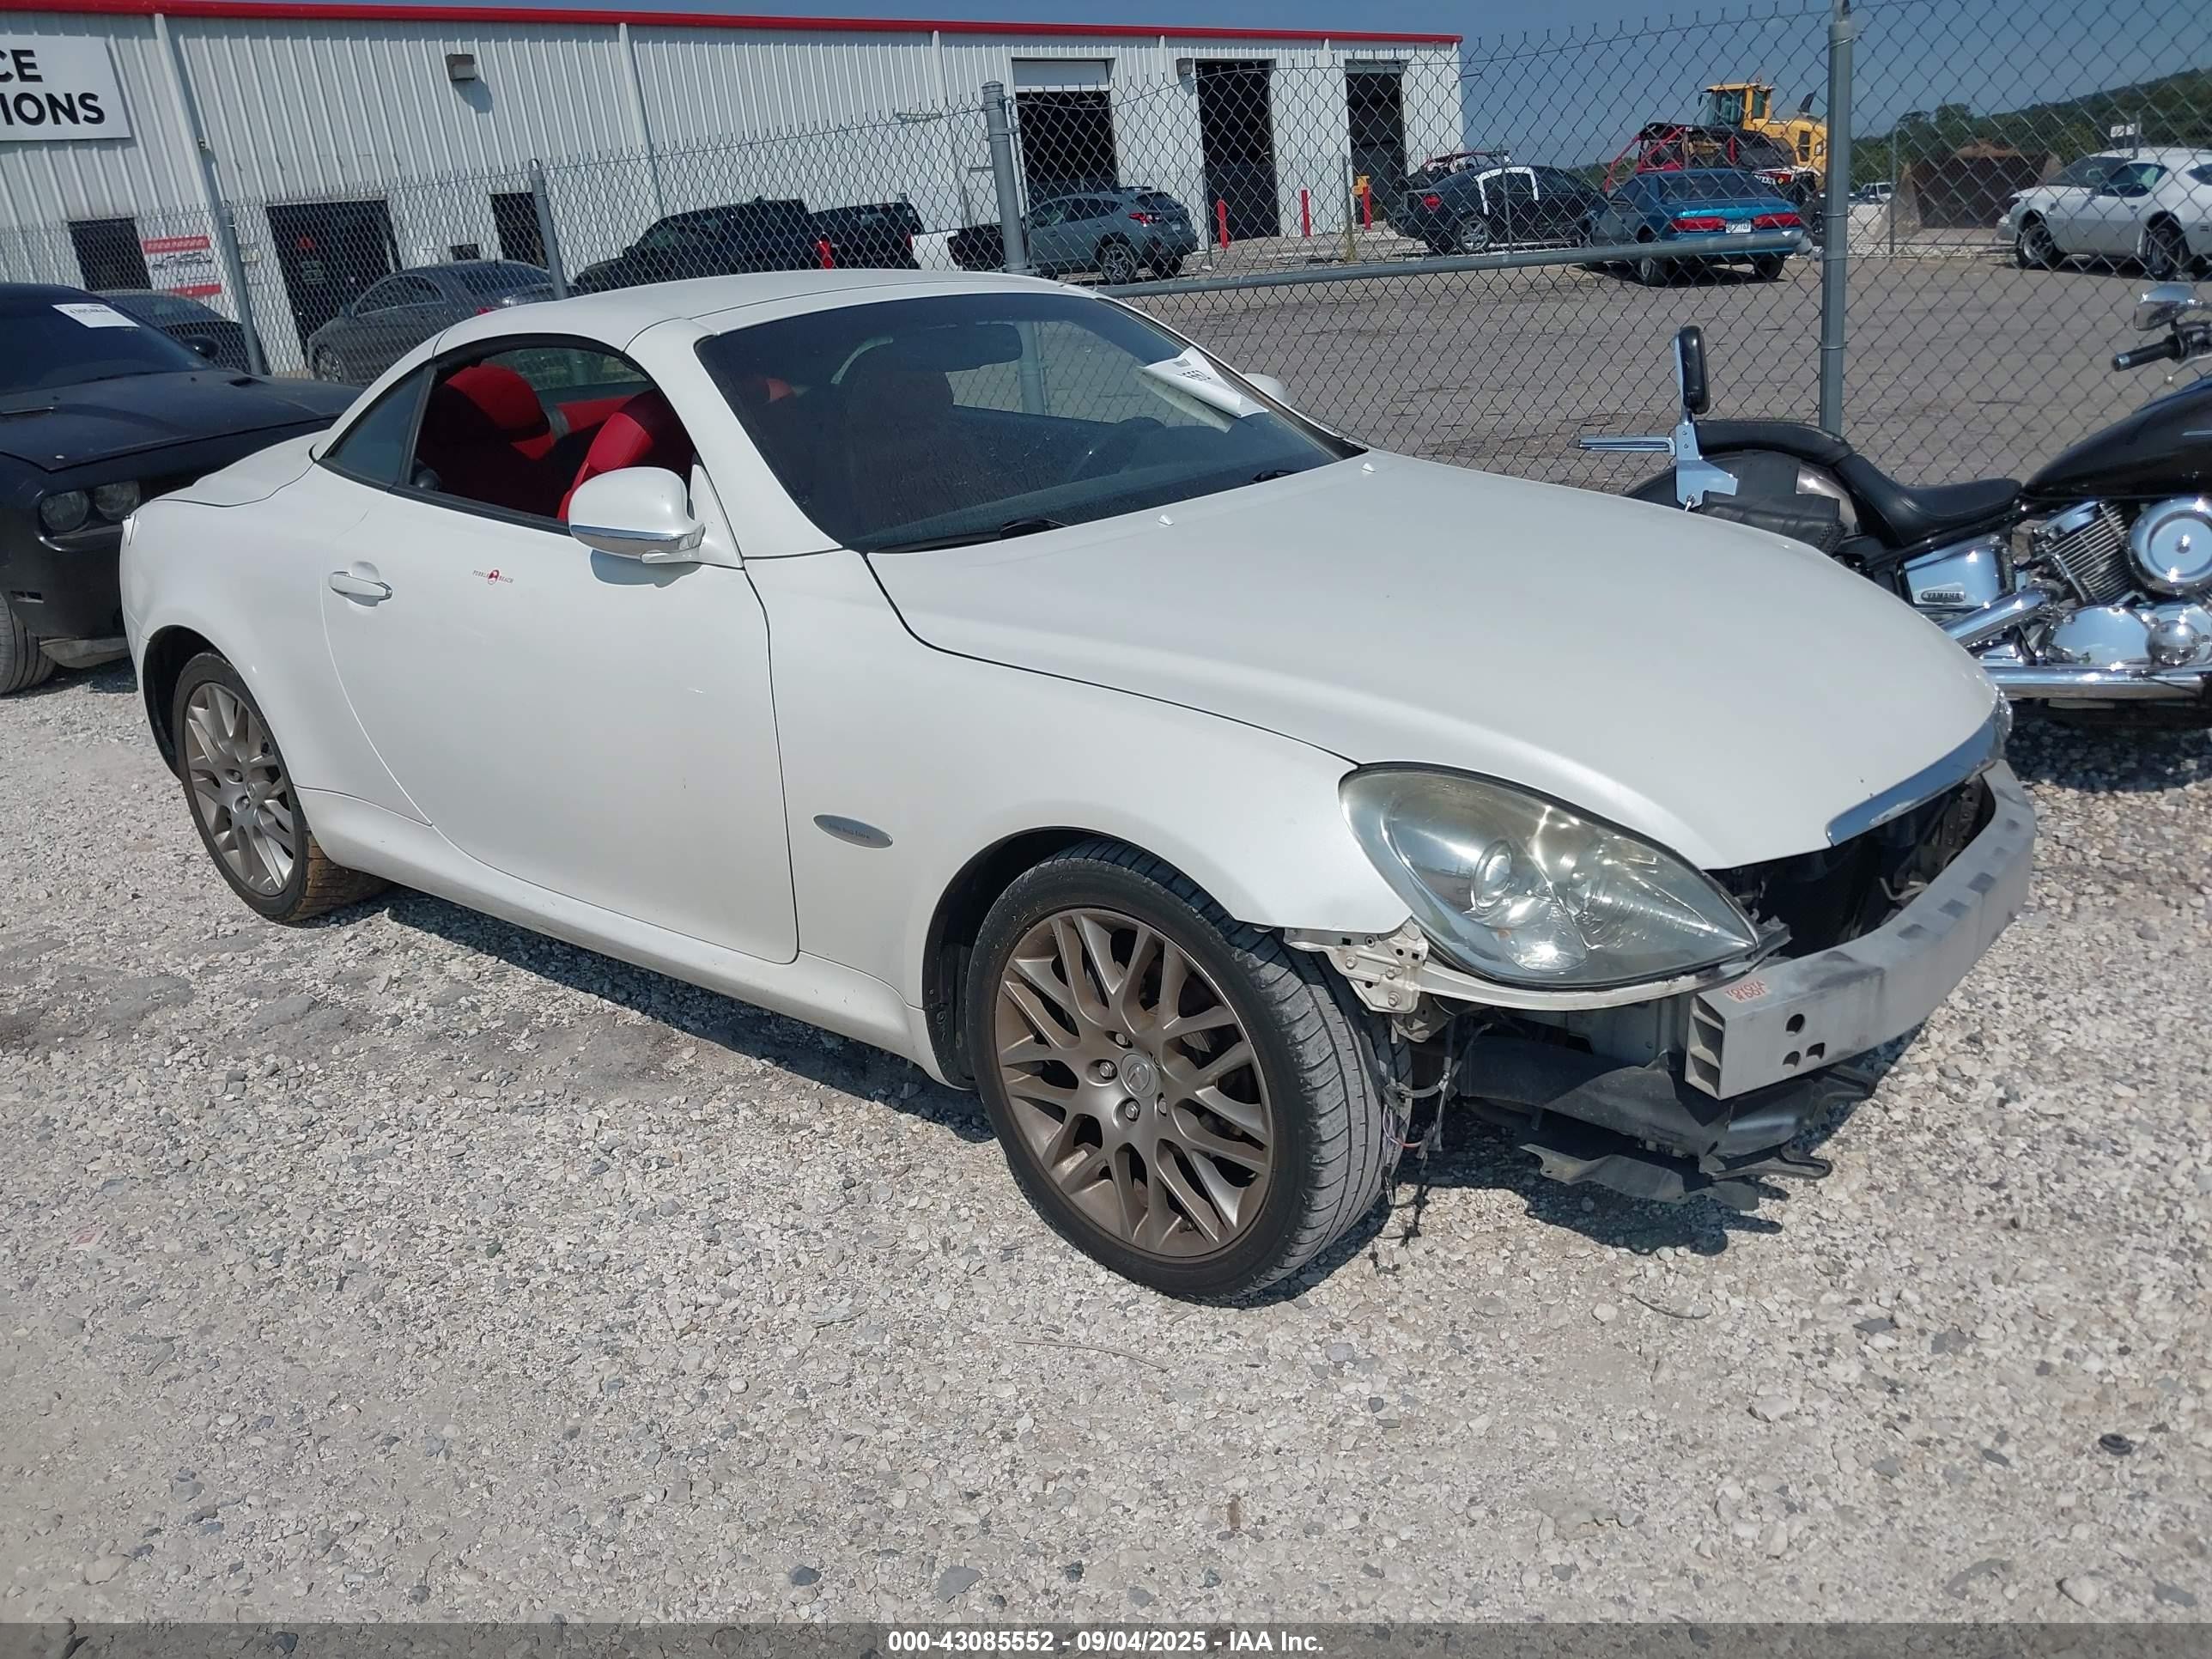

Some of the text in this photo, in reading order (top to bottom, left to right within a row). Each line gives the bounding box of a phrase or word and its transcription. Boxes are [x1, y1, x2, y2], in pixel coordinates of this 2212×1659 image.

[0, 92, 105, 125] IONS
[1926, 591, 1961, 599] YAMAHA
[1726, 981, 1765, 997] TOYOTA
